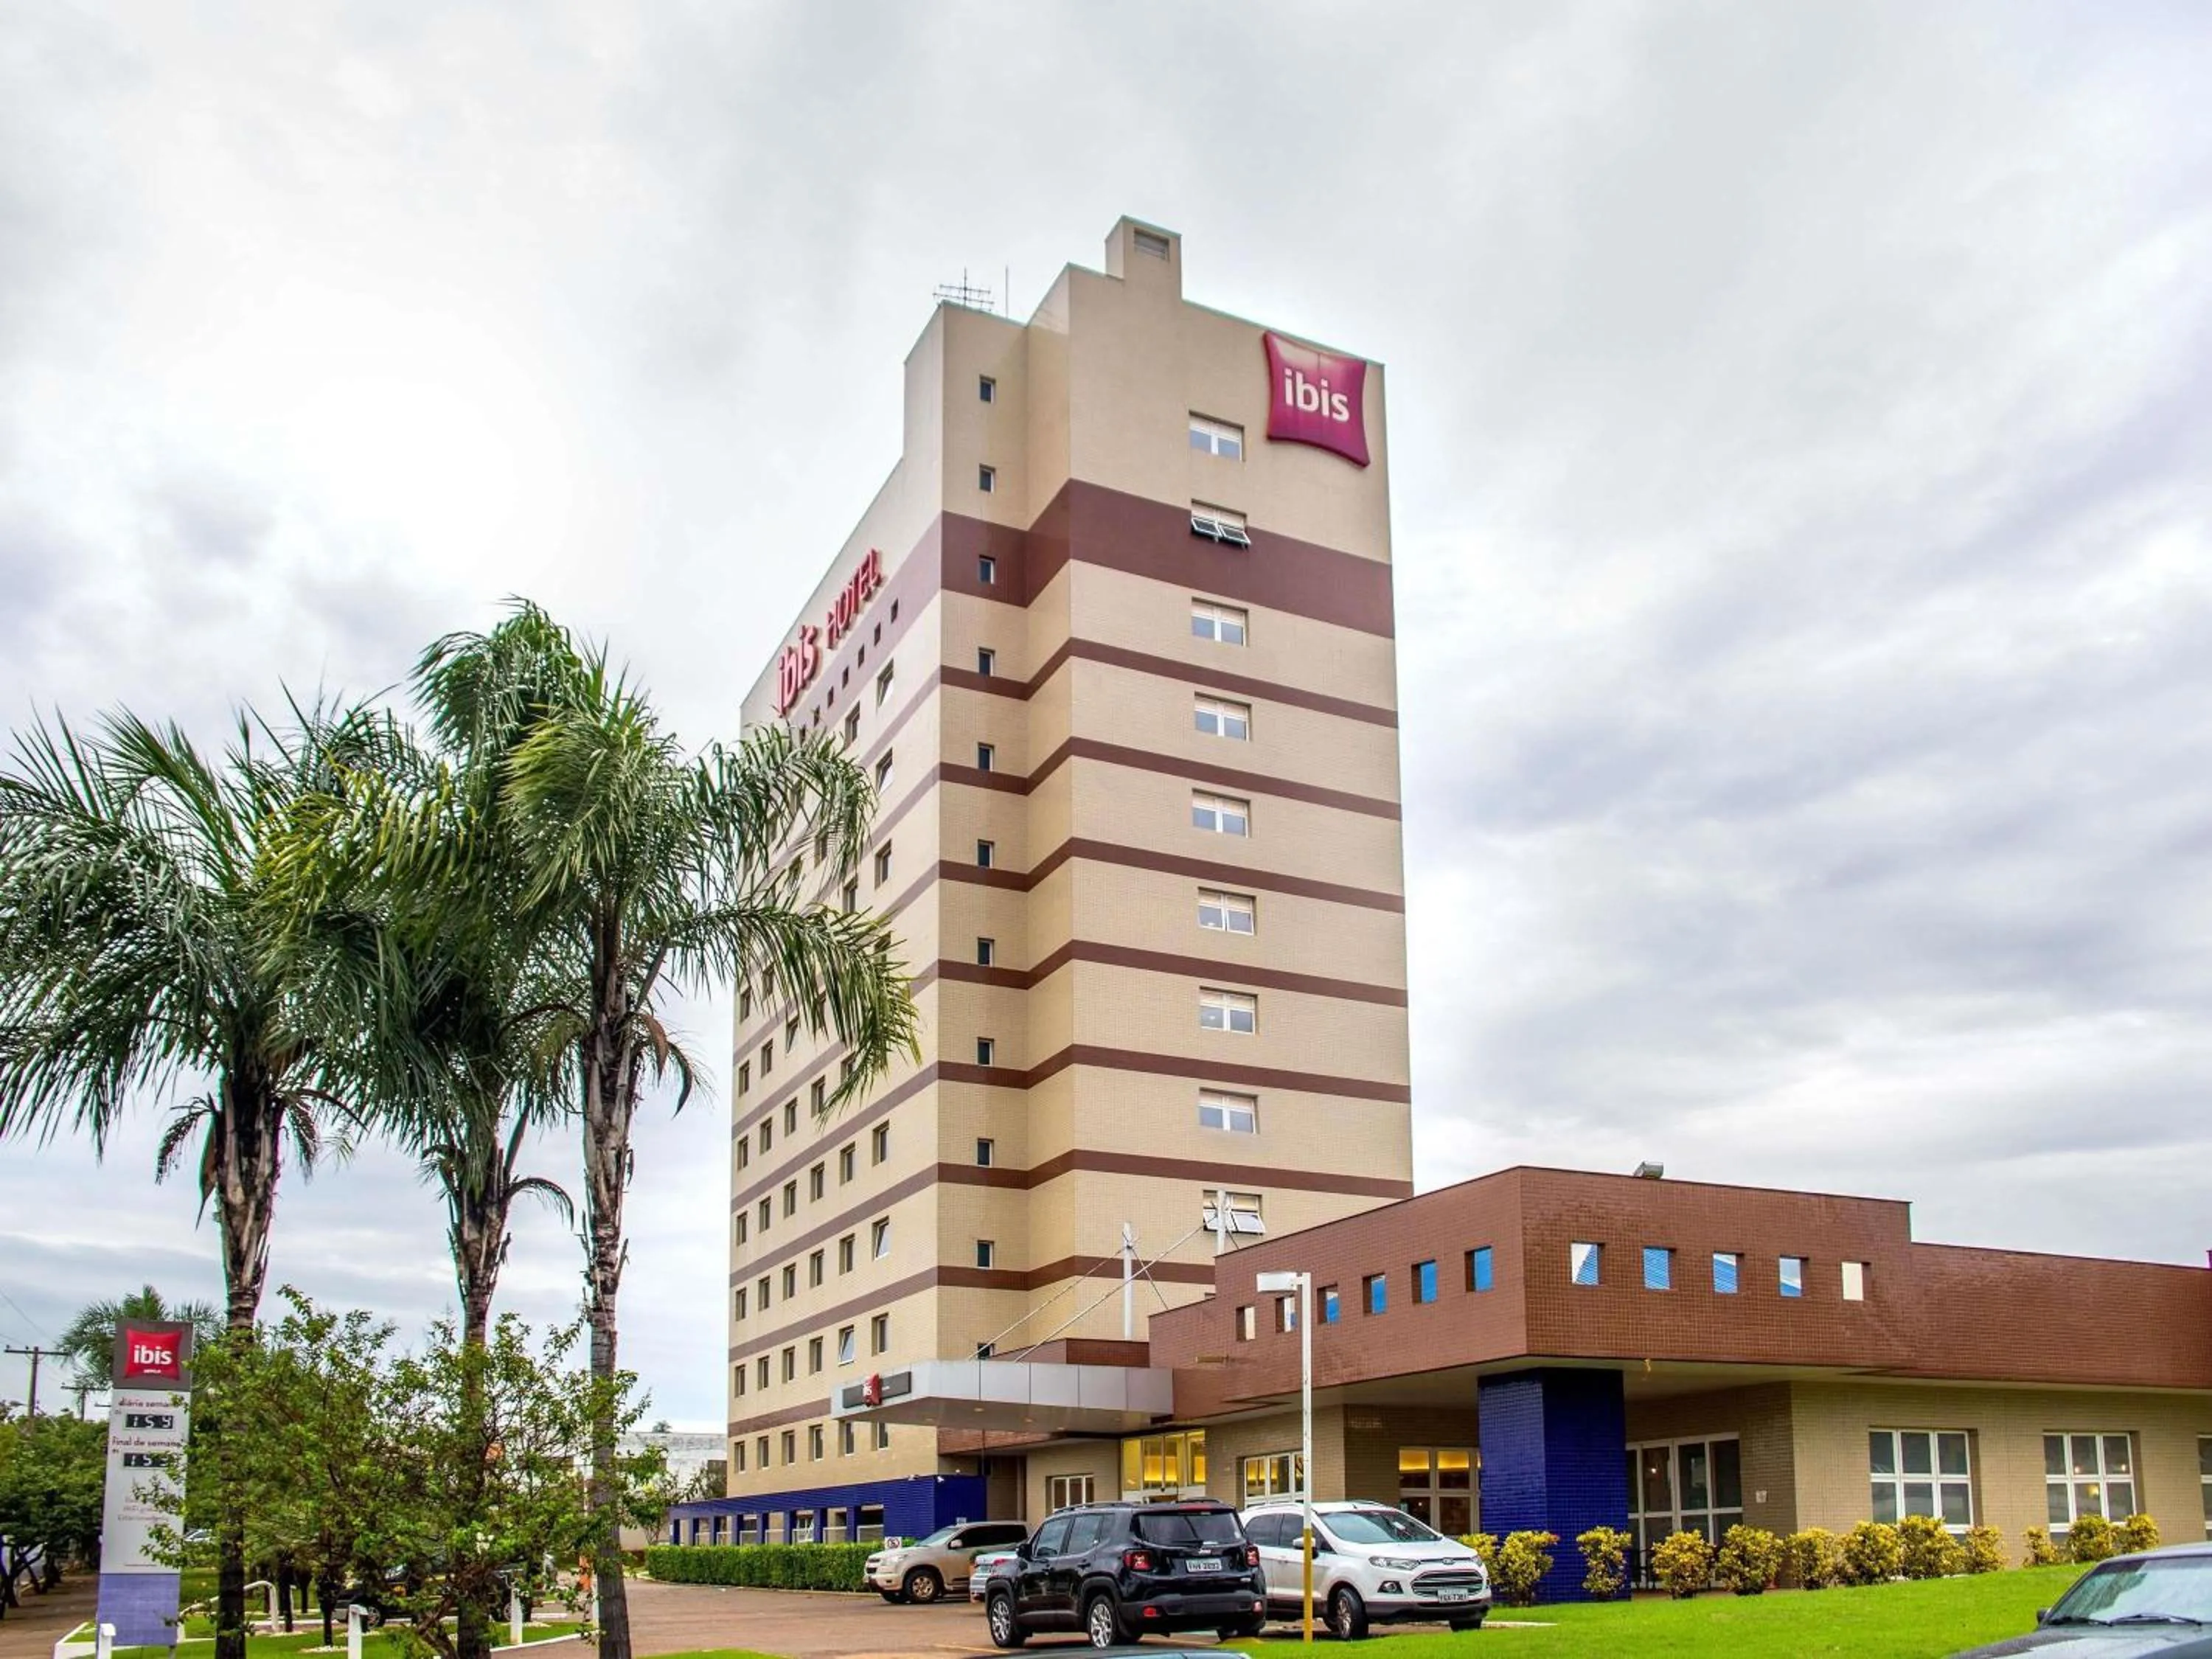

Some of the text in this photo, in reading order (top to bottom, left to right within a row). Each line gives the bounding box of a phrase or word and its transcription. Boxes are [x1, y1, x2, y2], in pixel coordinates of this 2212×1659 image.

[1284, 367, 1350, 422] ibis
[779, 548, 882, 718] ibis HOTEL
[133, 1344, 173, 1365] ibis
[134, 1436, 145, 1446] de
